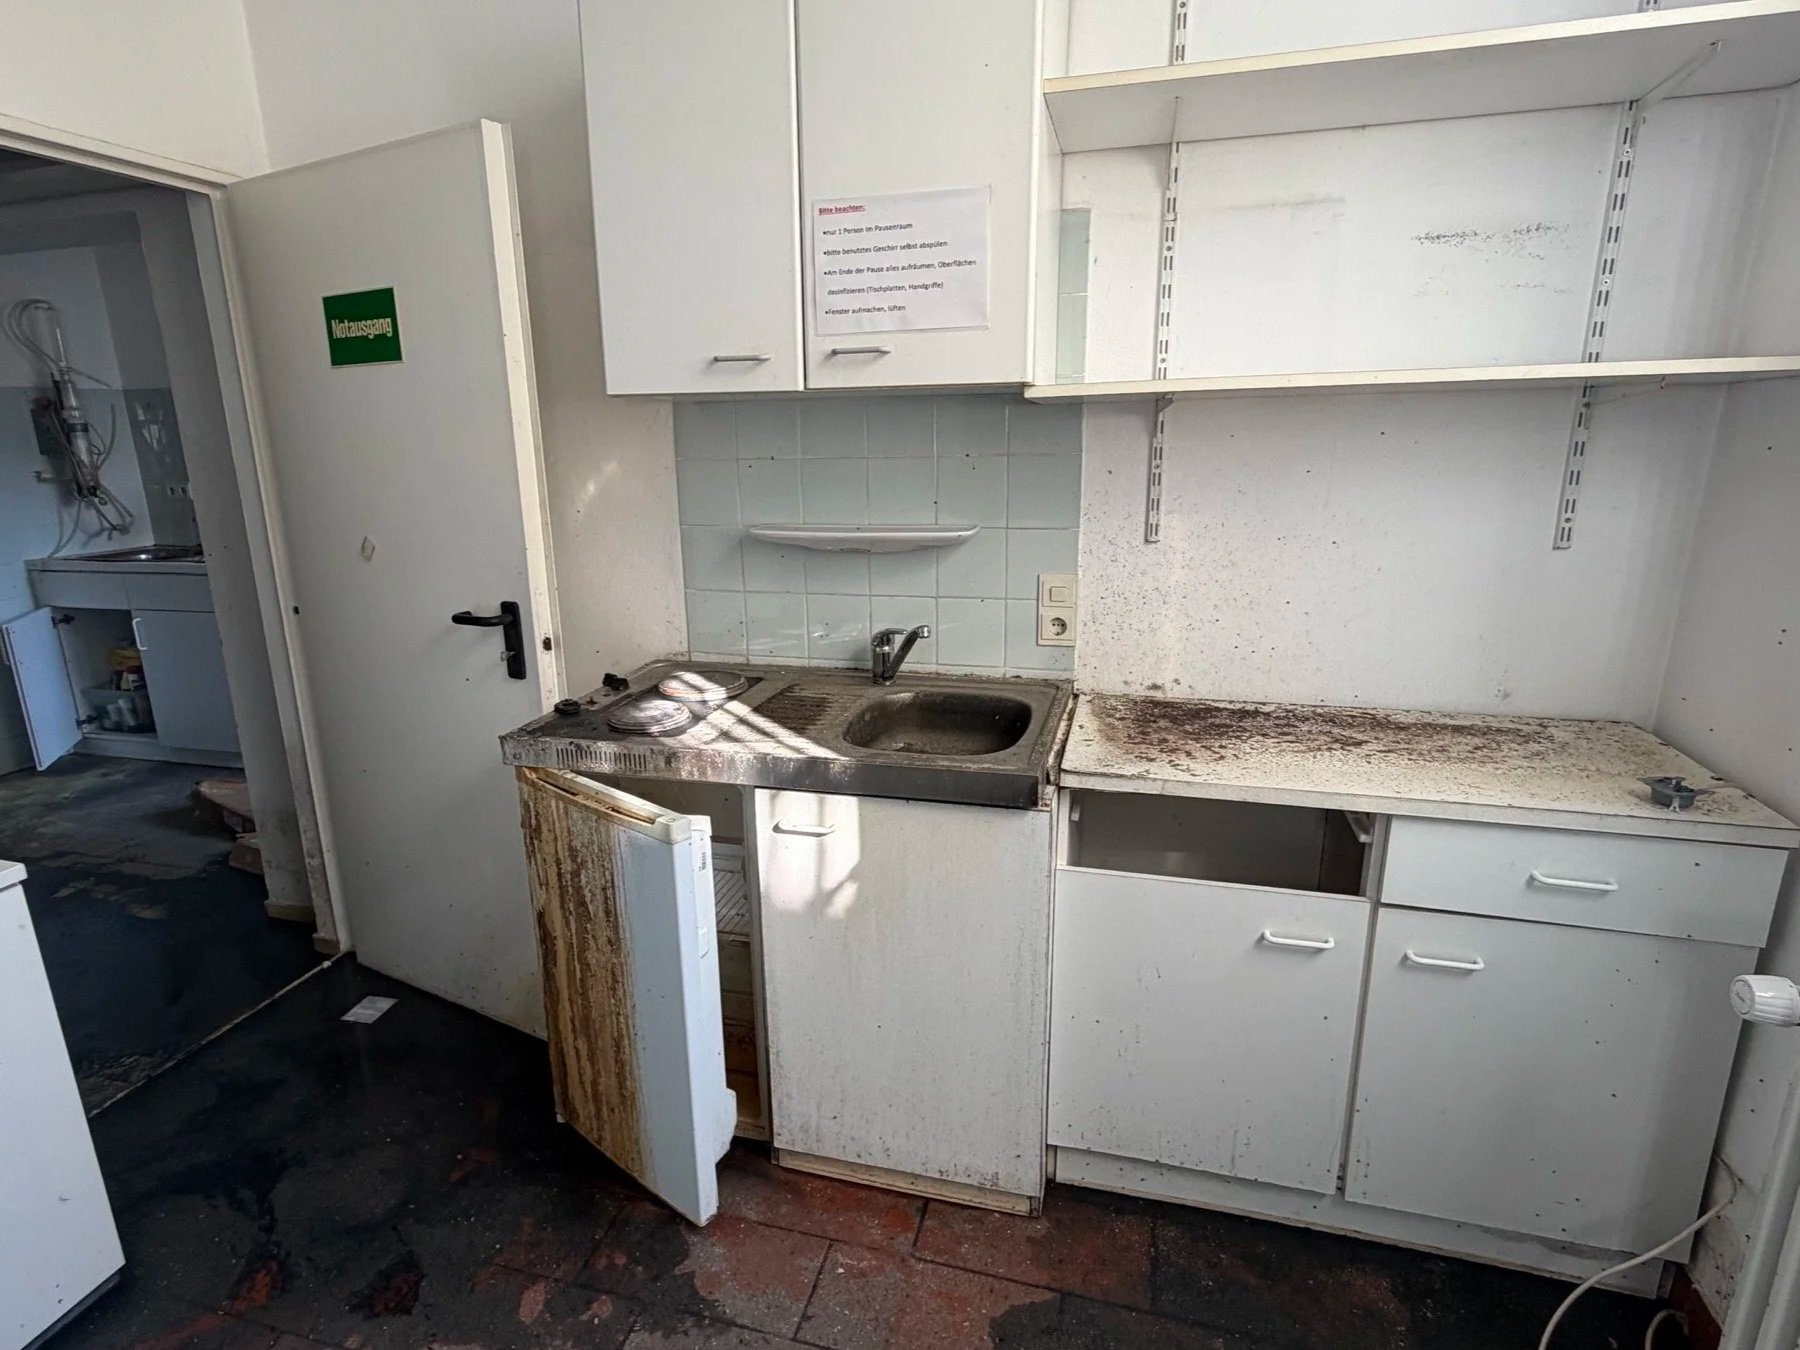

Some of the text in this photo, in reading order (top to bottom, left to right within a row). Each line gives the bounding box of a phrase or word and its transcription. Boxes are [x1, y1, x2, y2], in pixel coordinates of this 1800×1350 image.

[874, 223, 912, 231] Pausenraum
[842, 247, 872, 255] benutztes
[920, 240, 948, 249] abspülen
[901, 263, 936, 271] aufräumen,
[938, 260, 976, 268] Oberflächen
[827, 287, 865, 295] desinfizieren
[852, 306, 886, 314] aufmachen,
[888, 304, 906, 312] lüften
[331, 318, 393, 339] Notausgang
